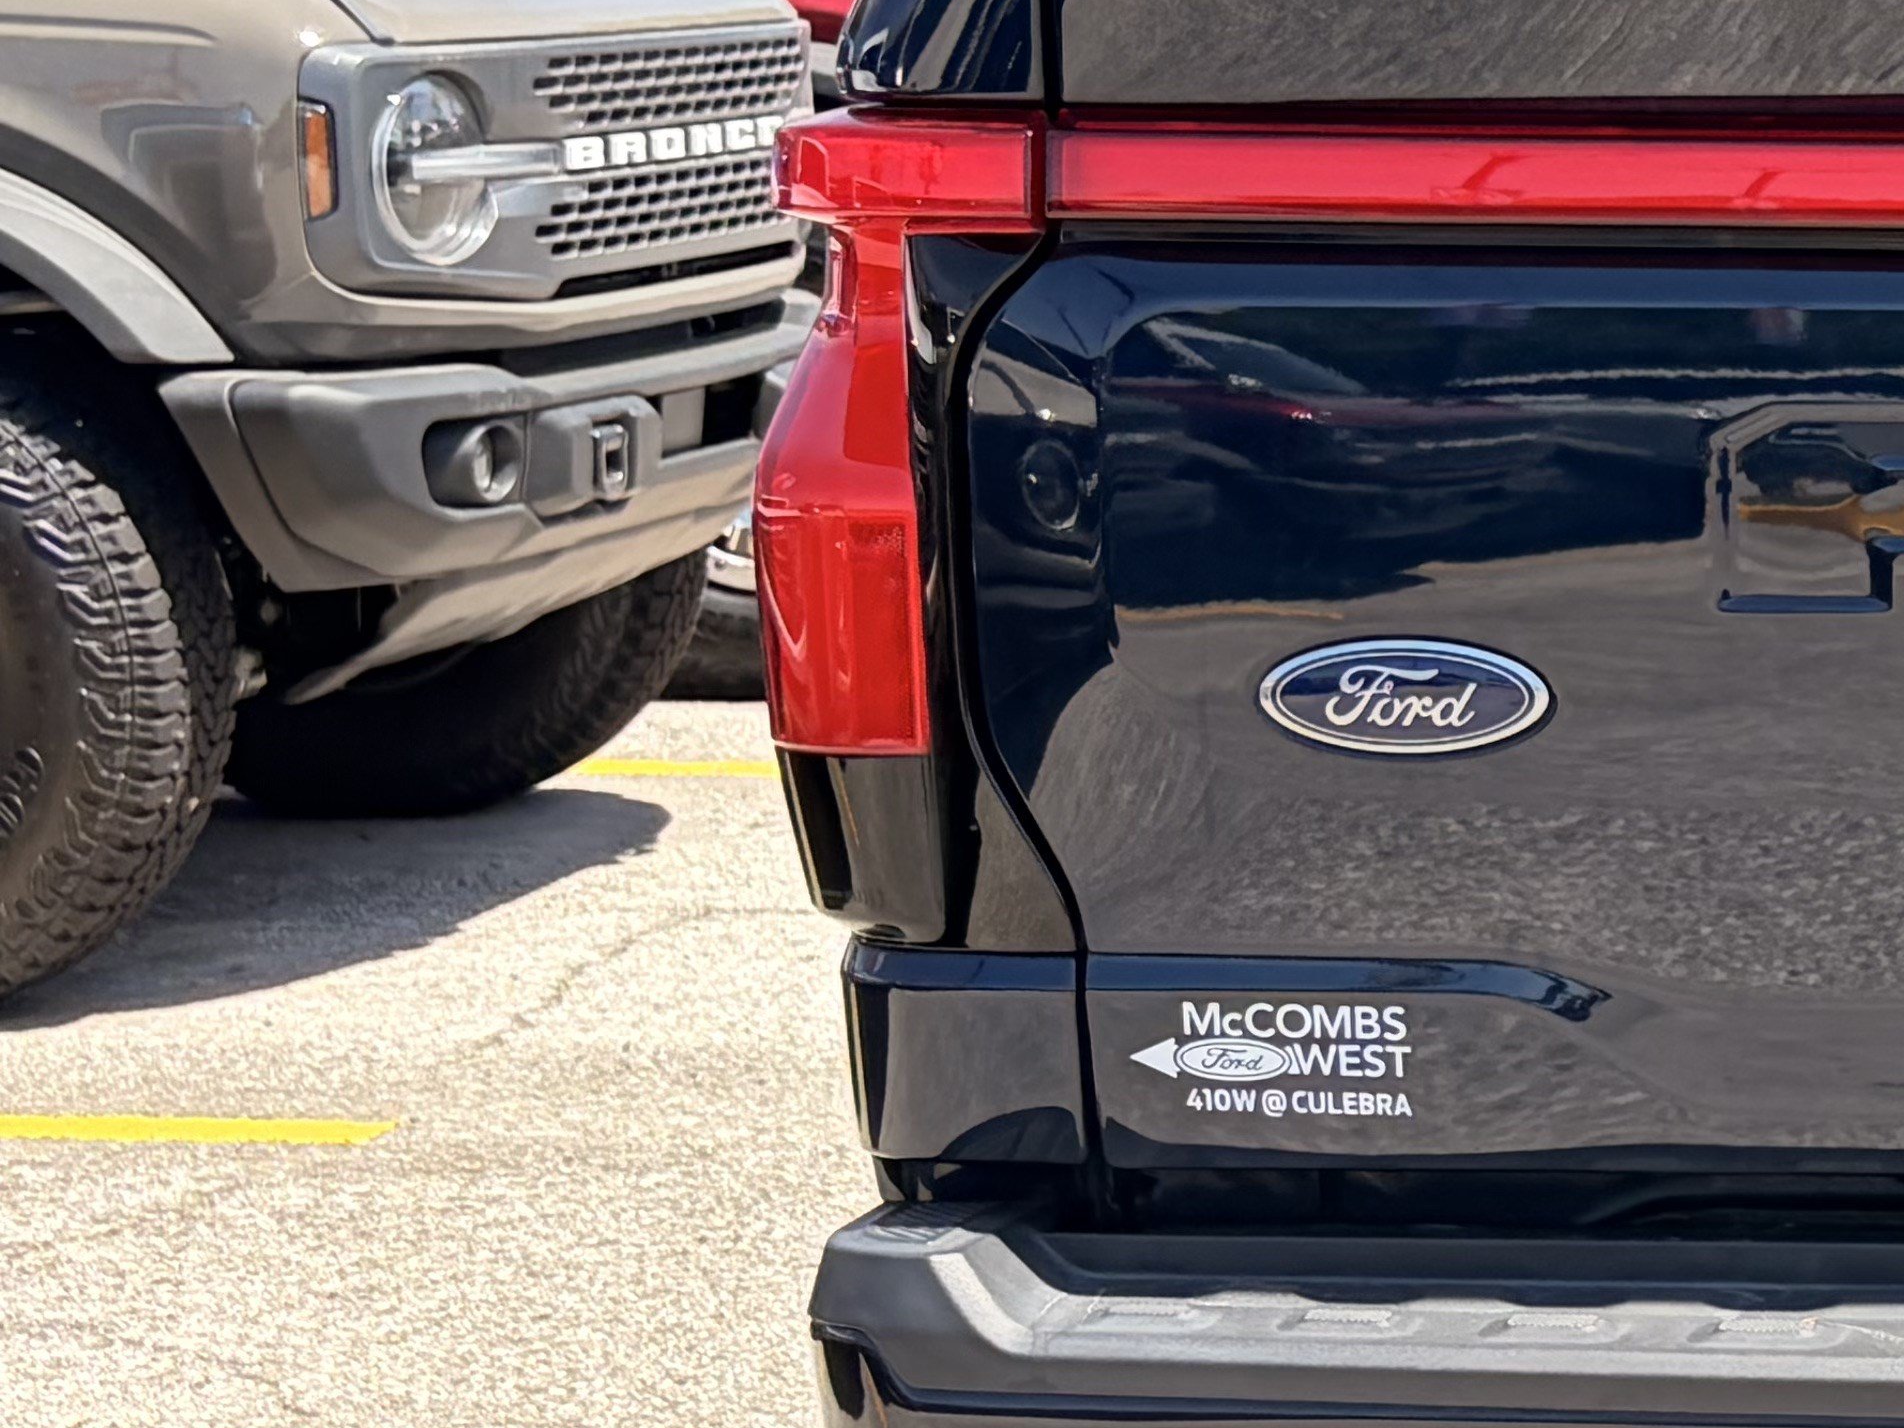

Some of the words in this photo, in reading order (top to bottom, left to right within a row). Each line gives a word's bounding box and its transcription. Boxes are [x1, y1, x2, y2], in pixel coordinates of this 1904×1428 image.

[1323, 663, 1478, 728] Ford
[1181, 1000, 1409, 1042] McCOMBS
[1200, 1047, 1264, 1072] Ford
[1296, 1042, 1412, 1078] WEST
[1291, 1089, 1414, 1118] CULEBRA
